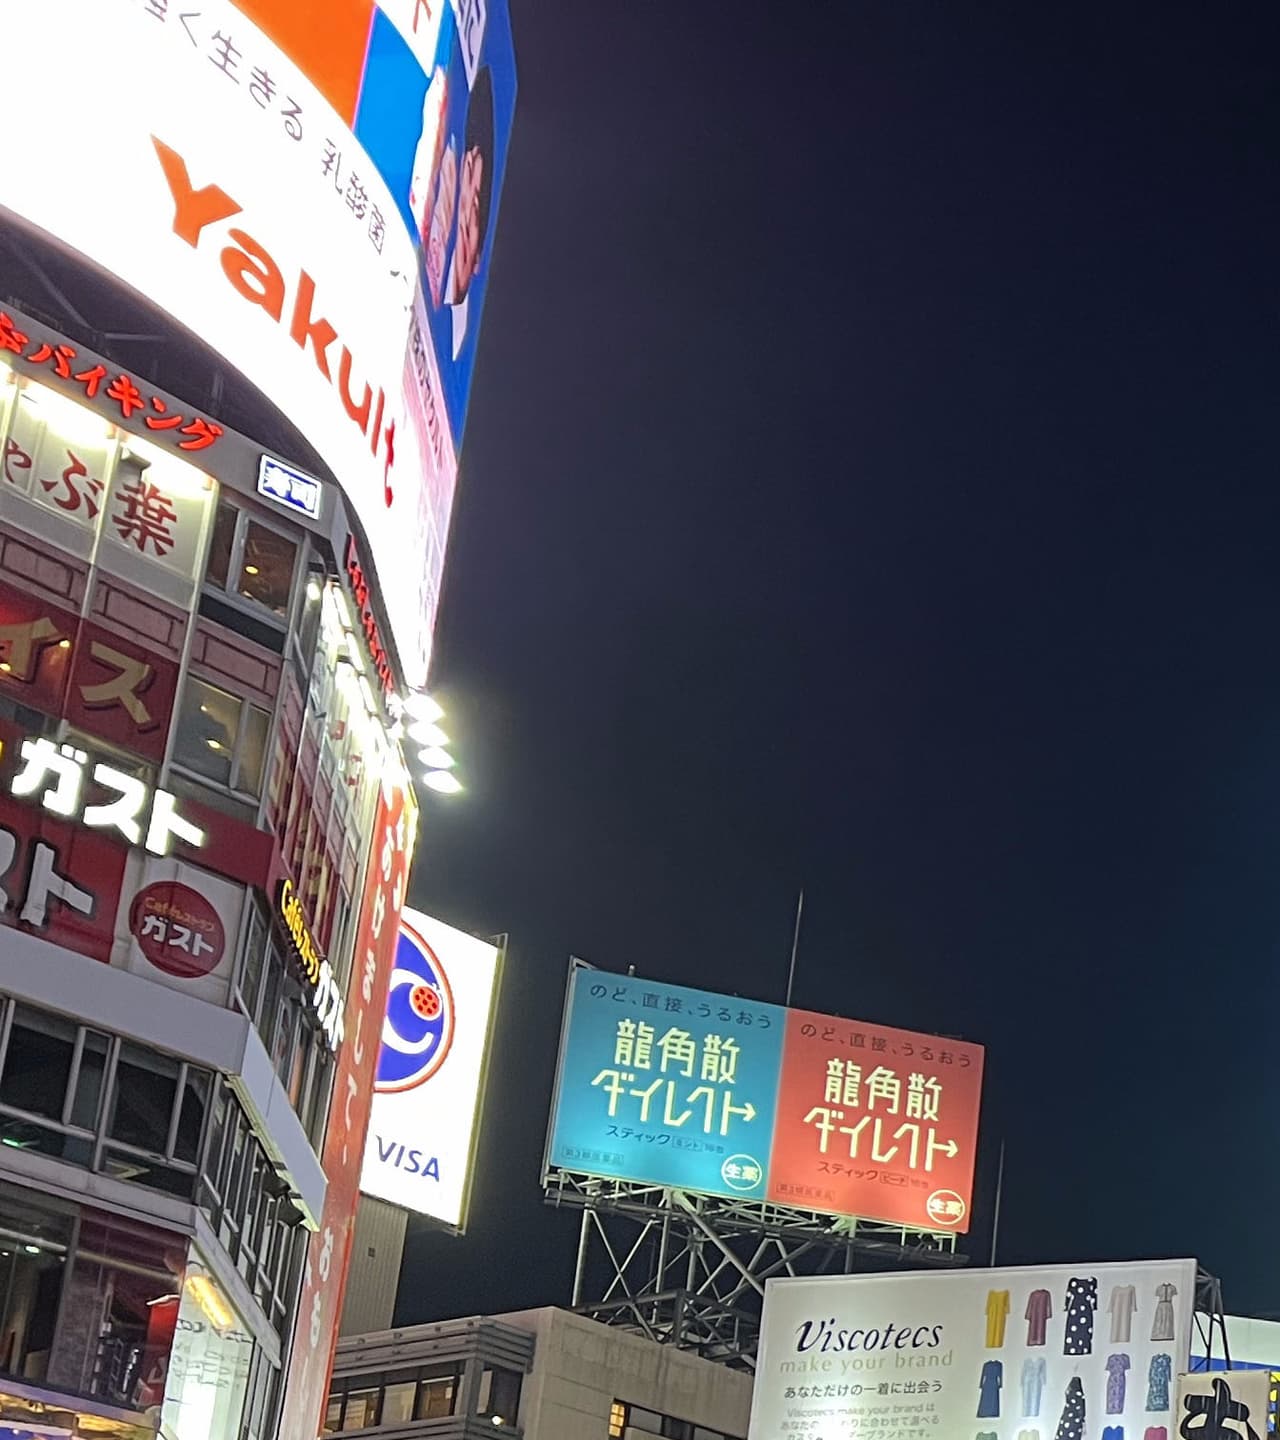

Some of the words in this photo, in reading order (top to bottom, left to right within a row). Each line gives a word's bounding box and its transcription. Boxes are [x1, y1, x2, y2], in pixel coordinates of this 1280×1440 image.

[144, 0, 303, 142] く生きる
[150, 133, 400, 508] Yakult
[11, 737, 205, 858] ガスト
[141, 914, 214, 957] ガスト
[614, 1018, 742, 1085] 龍角散
[590, 1068, 758, 1136] ダイレクト
[825, 1057, 943, 1122] 龍角散
[376, 1134, 440, 1183] VISA
[606, 1122, 671, 1147] スティック
[803, 1106, 960, 1172] ダイレクト
[818, 1160, 879, 1184] スティック
[780, 1354, 833, 1376] make
[840, 1353, 889, 1377] your
[894, 1348, 954, 1370] brand
[795, 1316, 945, 1353] Viscotecs
[784, 1380, 943, 1400] あなただけの一着に出会う
